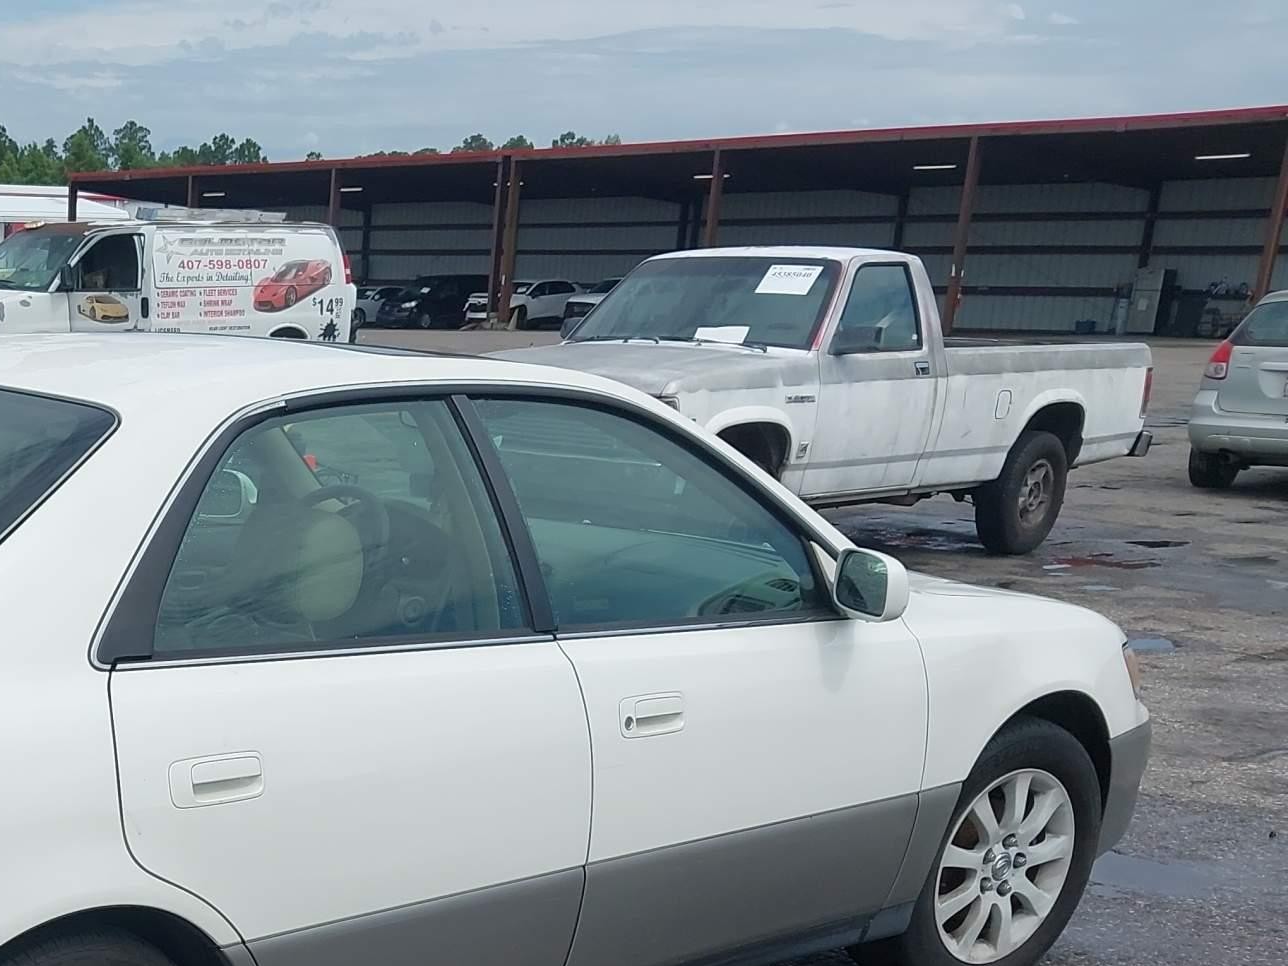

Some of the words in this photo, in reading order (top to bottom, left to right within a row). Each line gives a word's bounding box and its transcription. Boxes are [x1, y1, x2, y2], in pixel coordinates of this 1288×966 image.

[178, 259, 268, 270] 407-598-0807
[159, 271, 173, 283] The
[176, 271, 204, 285] Experts
[206, 272, 213, 282] in
[203, 289, 217, 297] FLEET
[217, 289, 237, 297] SERVICES
[160, 312, 171, 320] CLAY
[203, 310, 223, 318] INTERIOR
